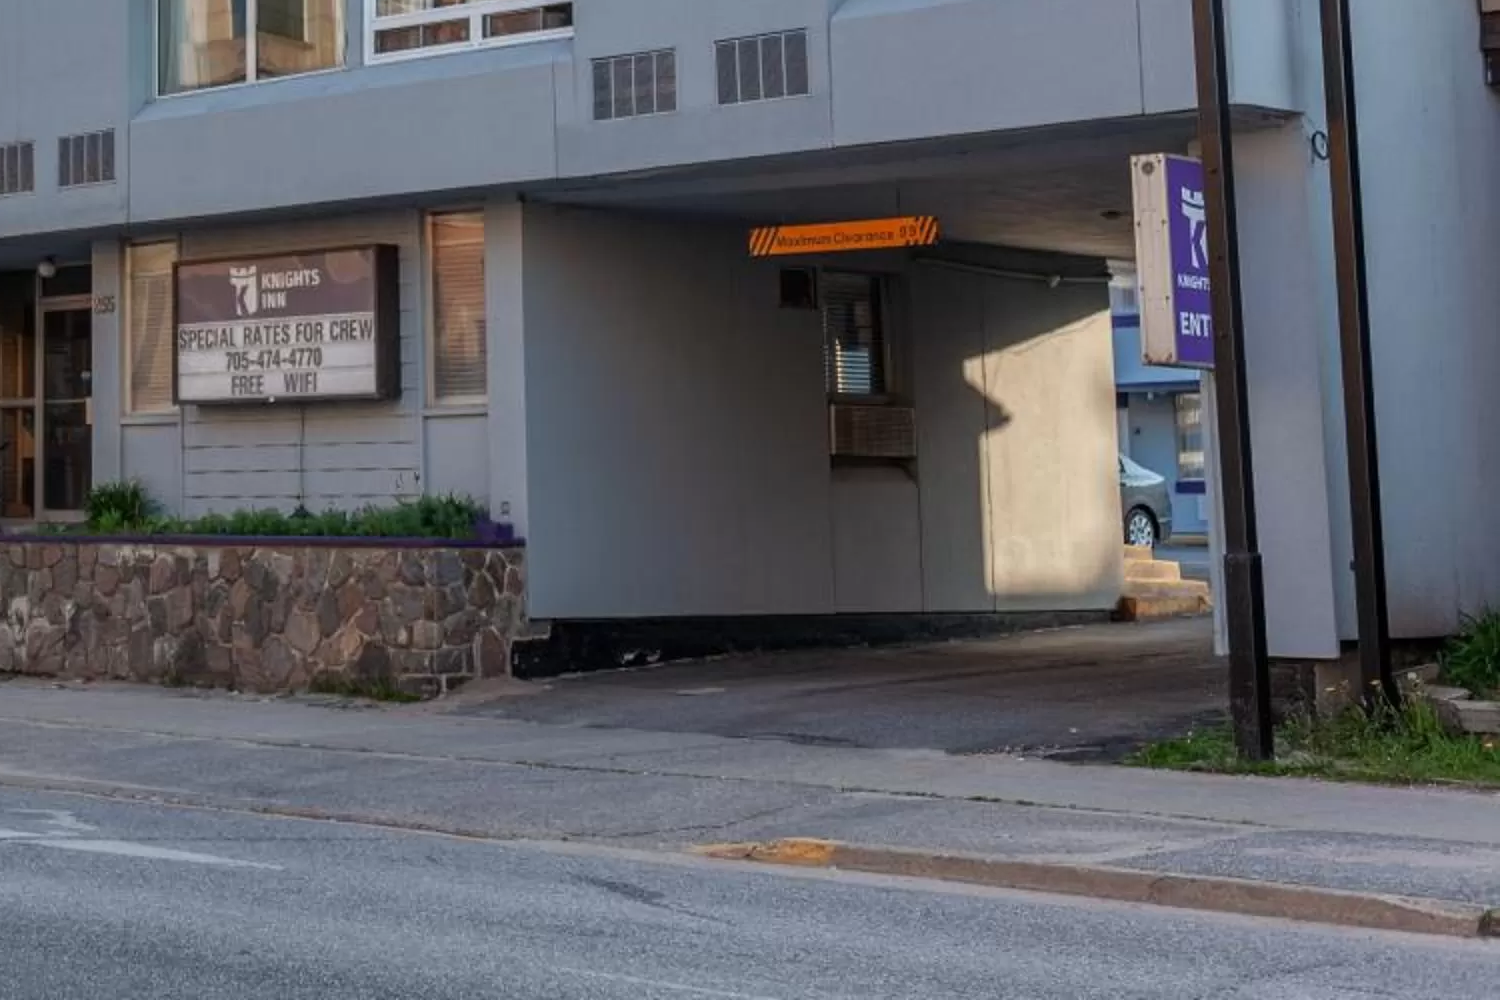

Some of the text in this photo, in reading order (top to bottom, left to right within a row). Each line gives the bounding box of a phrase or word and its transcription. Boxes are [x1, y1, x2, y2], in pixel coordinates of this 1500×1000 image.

[777, 234, 832, 248] Maximum
[834, 231, 895, 244] Clearance
[261, 268, 322, 289] KNIGHTS
[261, 291, 288, 309] INN
[179, 319, 373, 349] SPECIAL RATES FOR CREW
[1180, 311, 1212, 337] ENT
[226, 348, 323, 372] 705-474-4770
[231, 371, 318, 396] FREE WIFI
